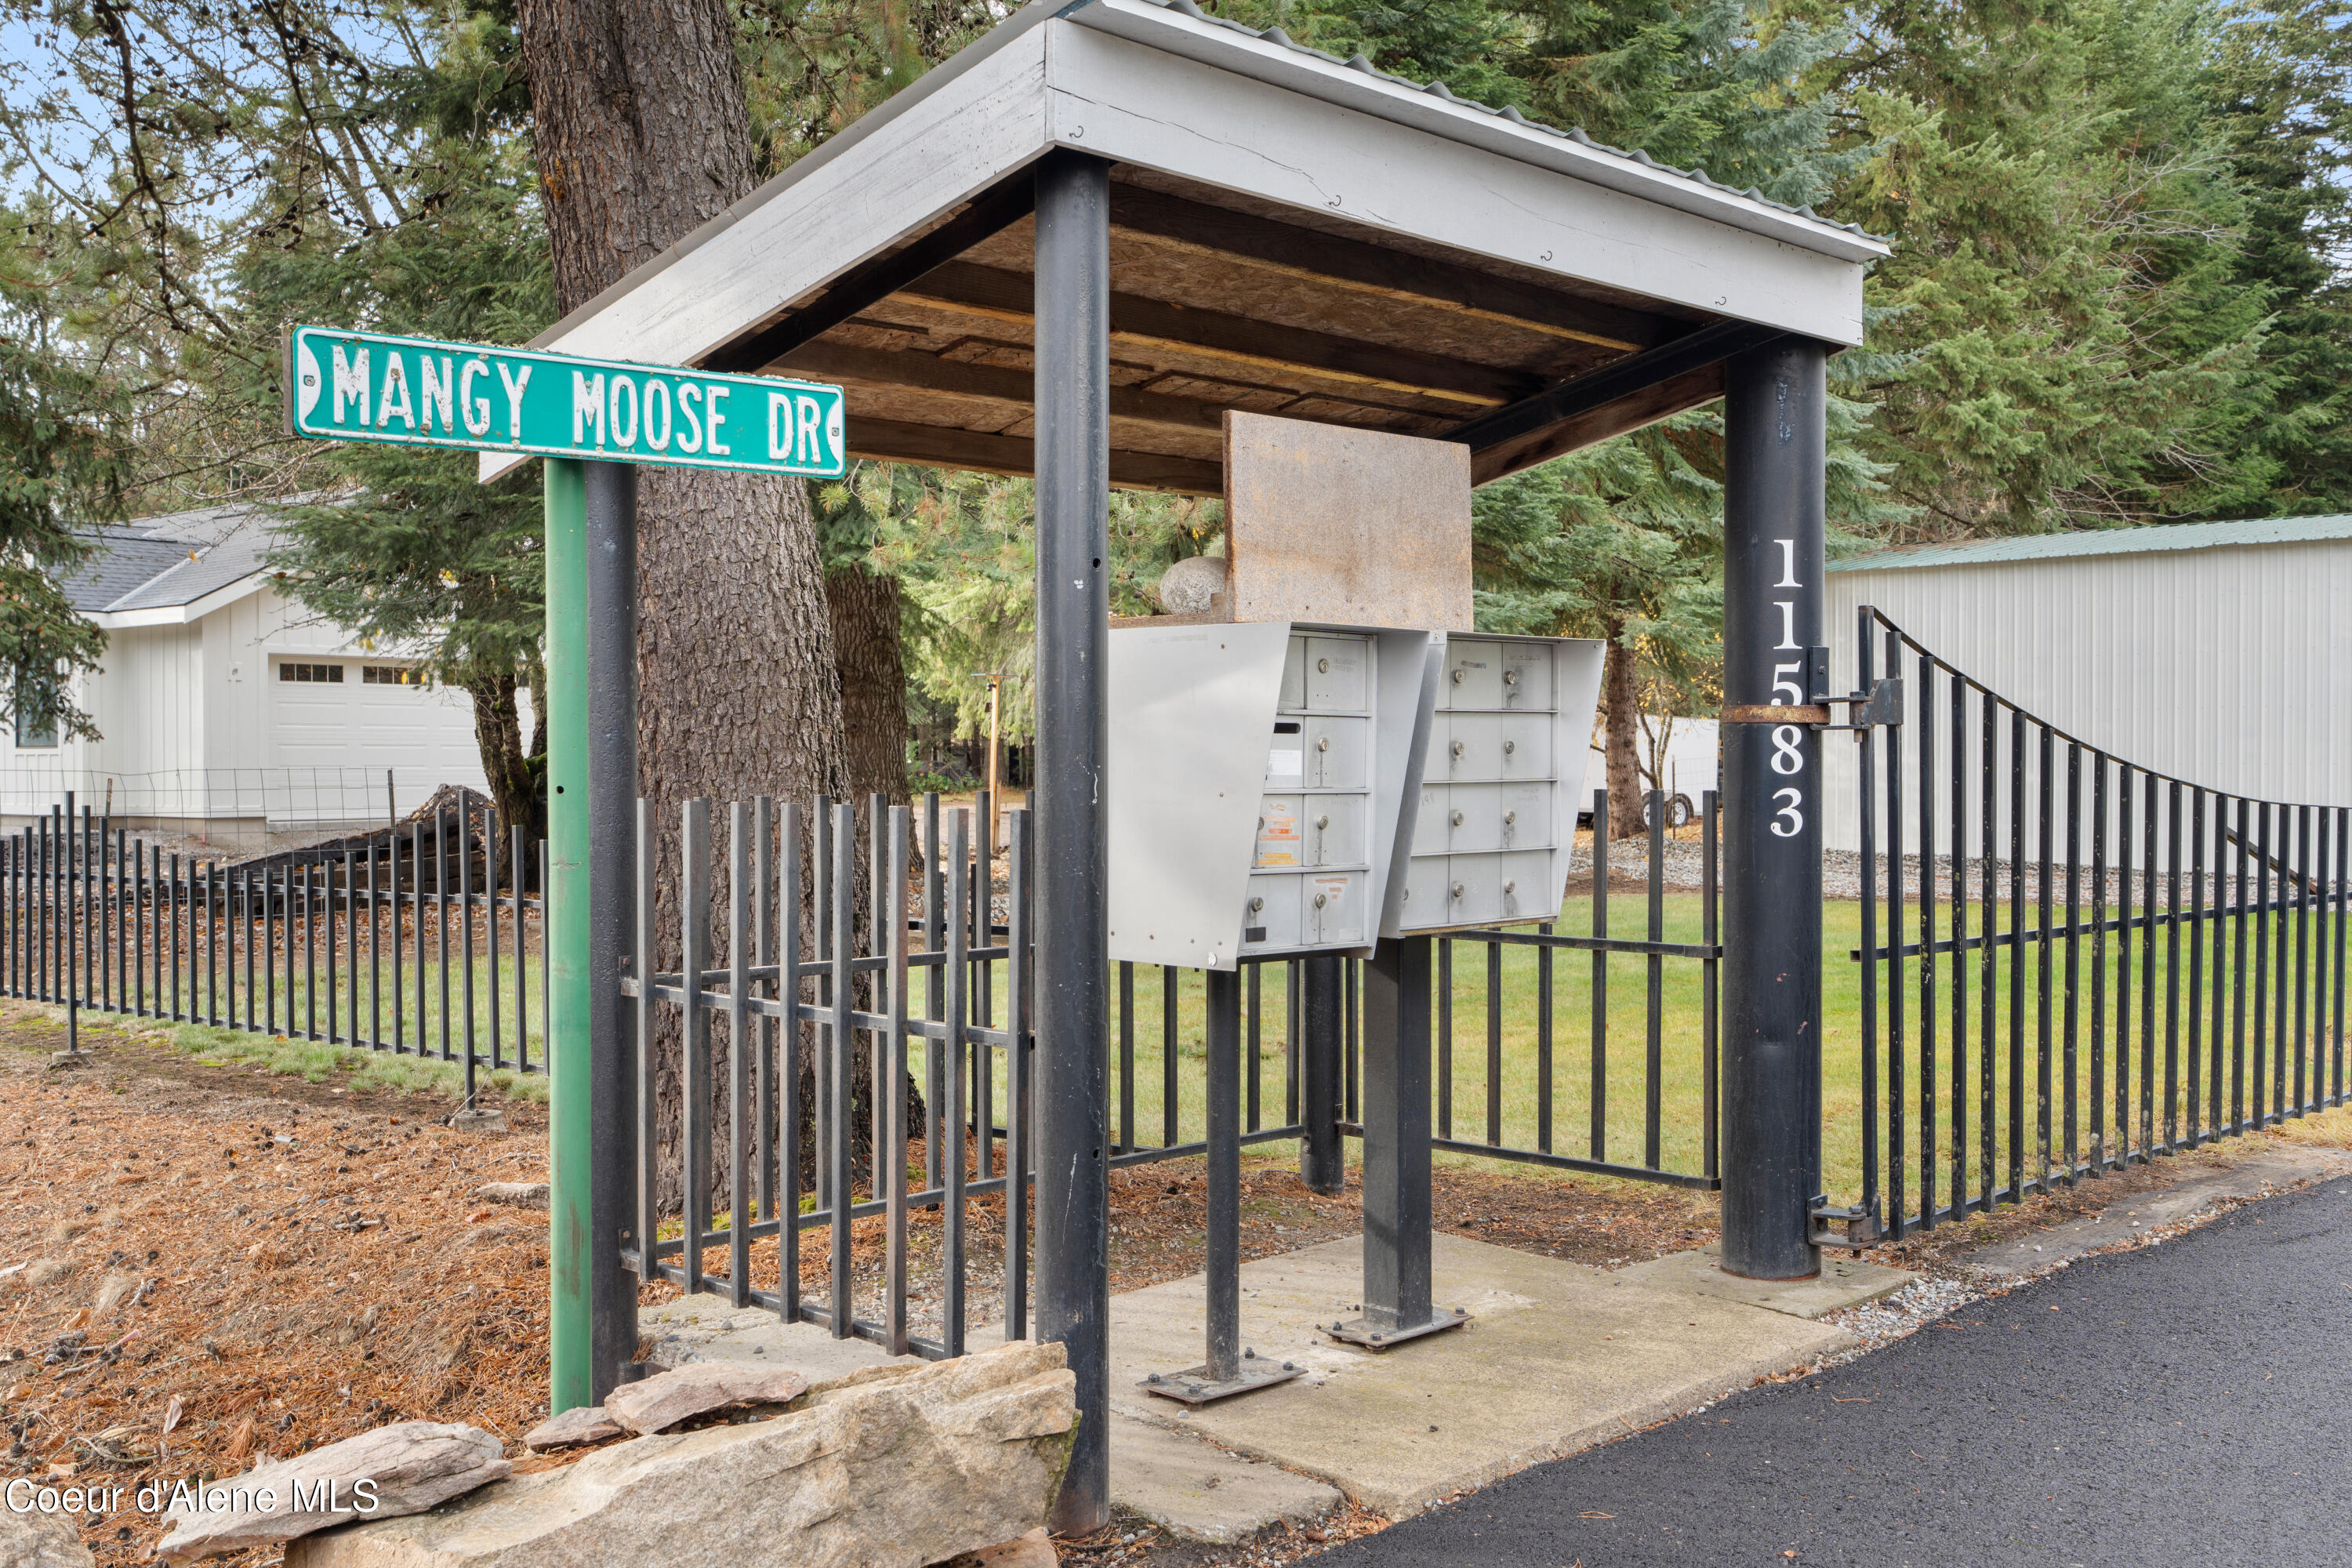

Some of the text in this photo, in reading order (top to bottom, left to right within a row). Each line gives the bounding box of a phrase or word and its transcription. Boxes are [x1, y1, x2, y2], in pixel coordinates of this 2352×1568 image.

[332, 345, 822, 464] MANGY MOOSE DR
[1770, 539, 1803, 837] 11583
